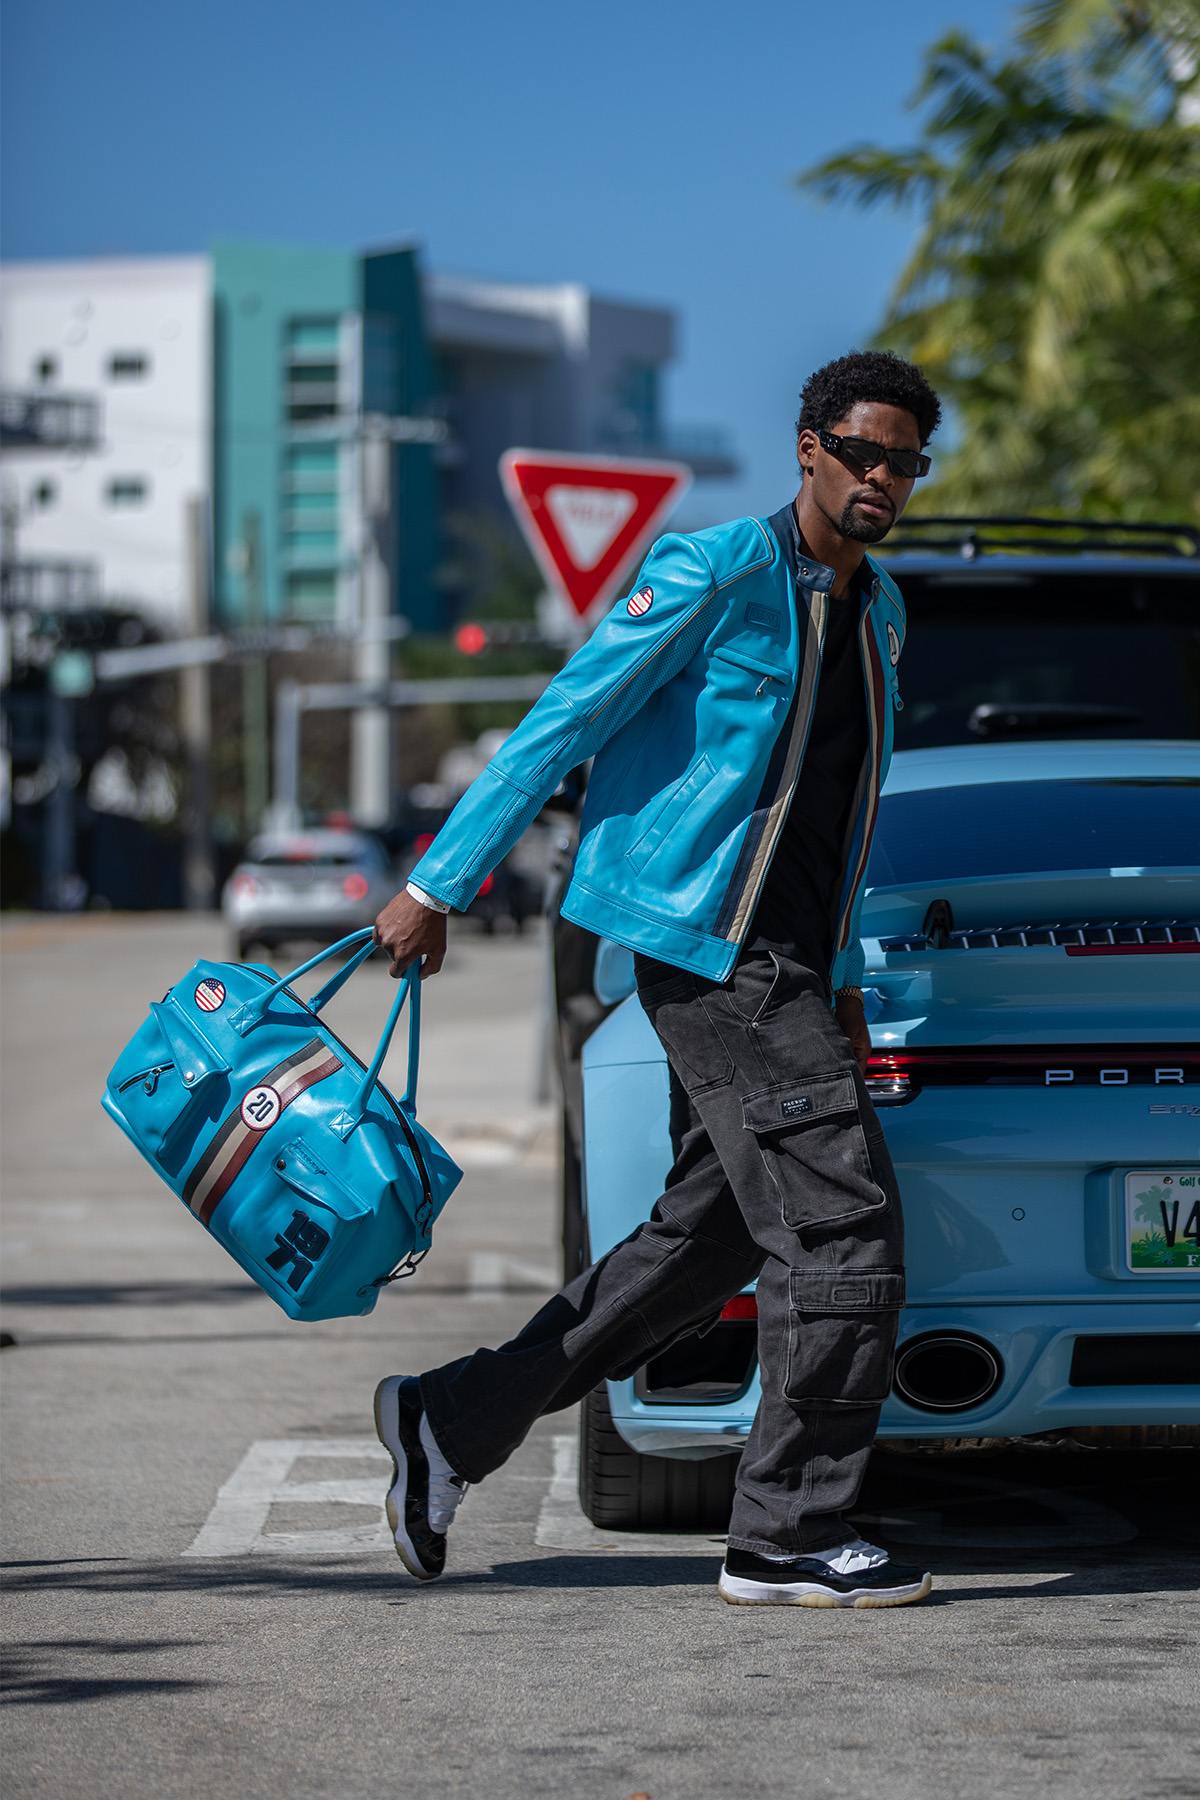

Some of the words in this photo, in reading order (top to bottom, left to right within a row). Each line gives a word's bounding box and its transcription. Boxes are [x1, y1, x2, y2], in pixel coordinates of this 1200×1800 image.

[1045, 1068, 1184, 1085] POR
[247, 1092, 275, 1122] 20
[1179, 1176, 1195, 1186] Golf
[283, 1209, 331, 1262] 19
